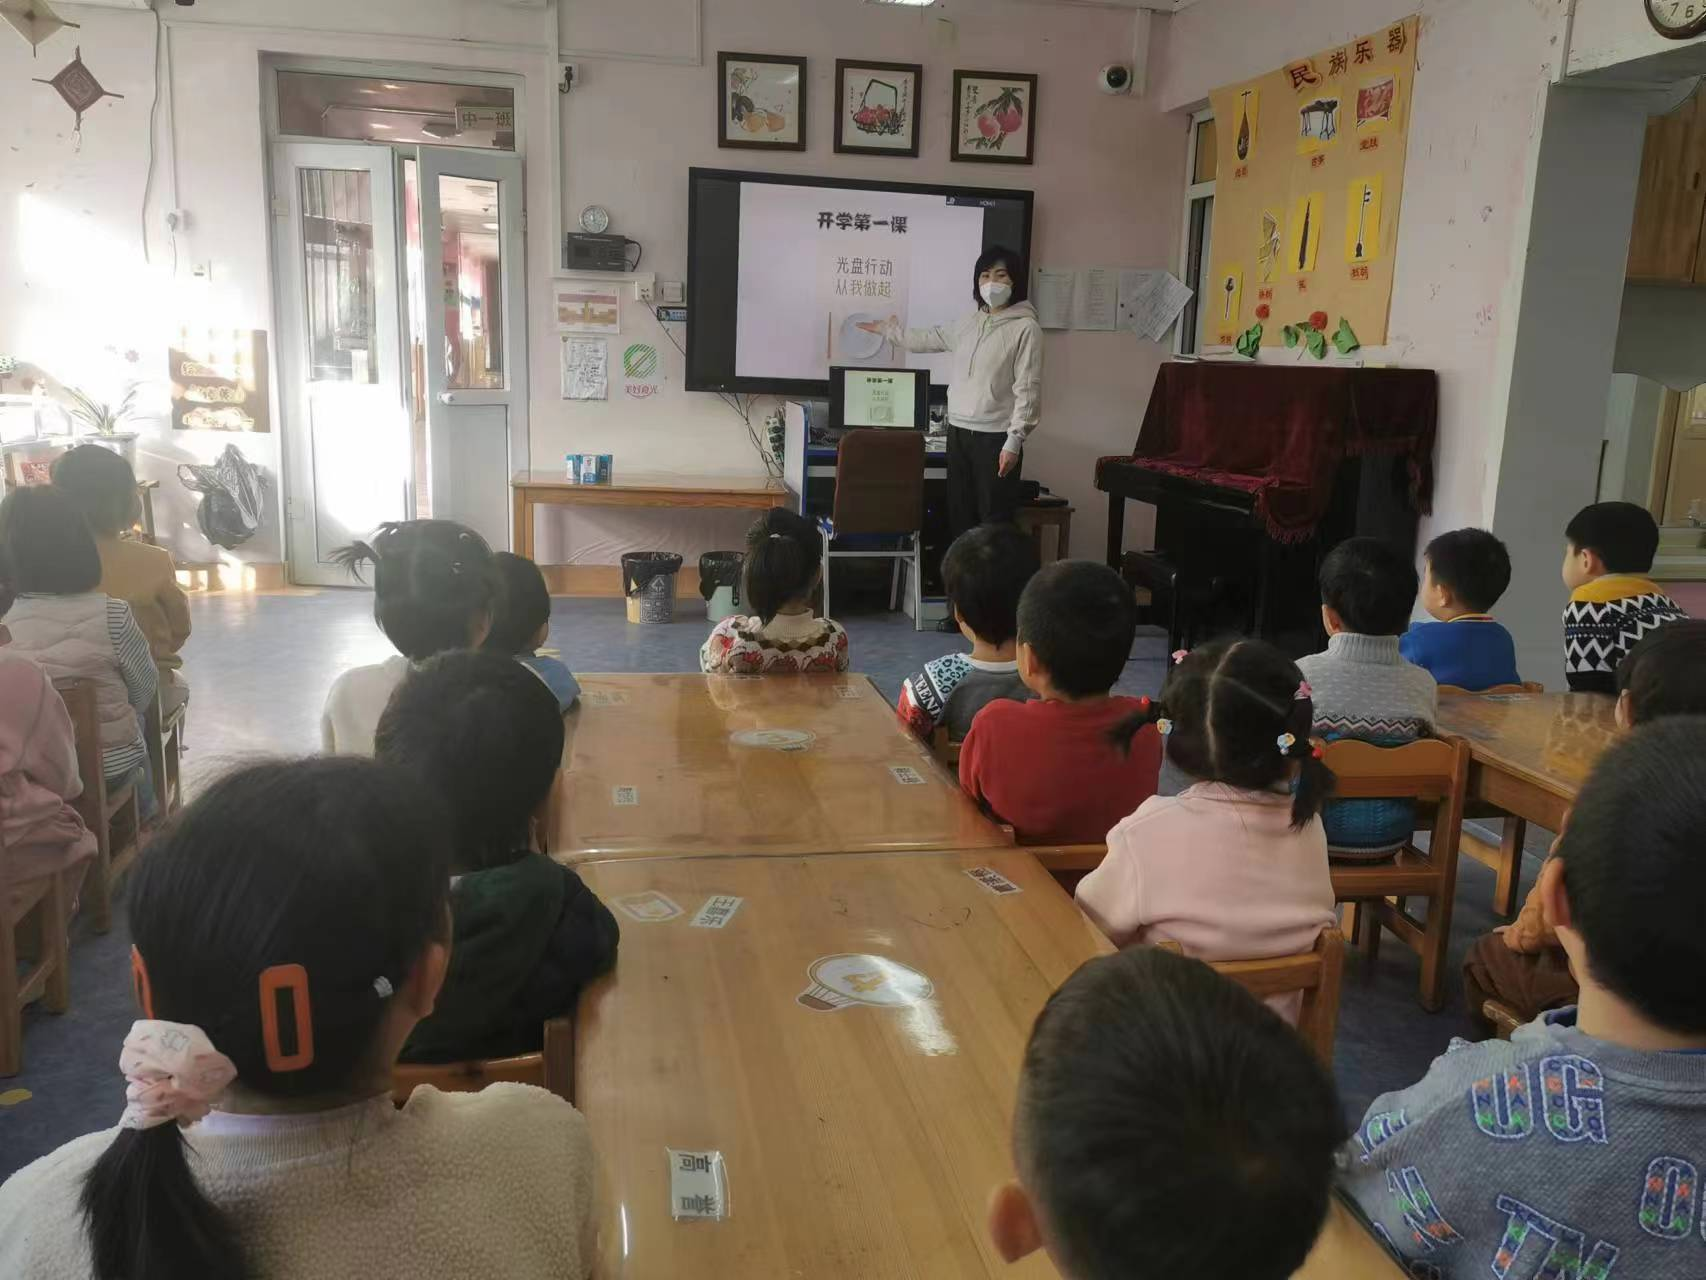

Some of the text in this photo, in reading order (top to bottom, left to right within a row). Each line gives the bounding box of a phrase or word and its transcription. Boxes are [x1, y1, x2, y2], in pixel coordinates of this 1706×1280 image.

[1670, 2, 1680, 17] 7
[1685, 5, 1695, 18] 6
[1290, 23, 1408, 90] 民族乐器
[462, 110, 513, 129] 中一班
[817, 211, 909, 234] 开学第一课
[836, 256, 894, 276] 光盘行动
[835, 278, 893, 299] 从我做起
